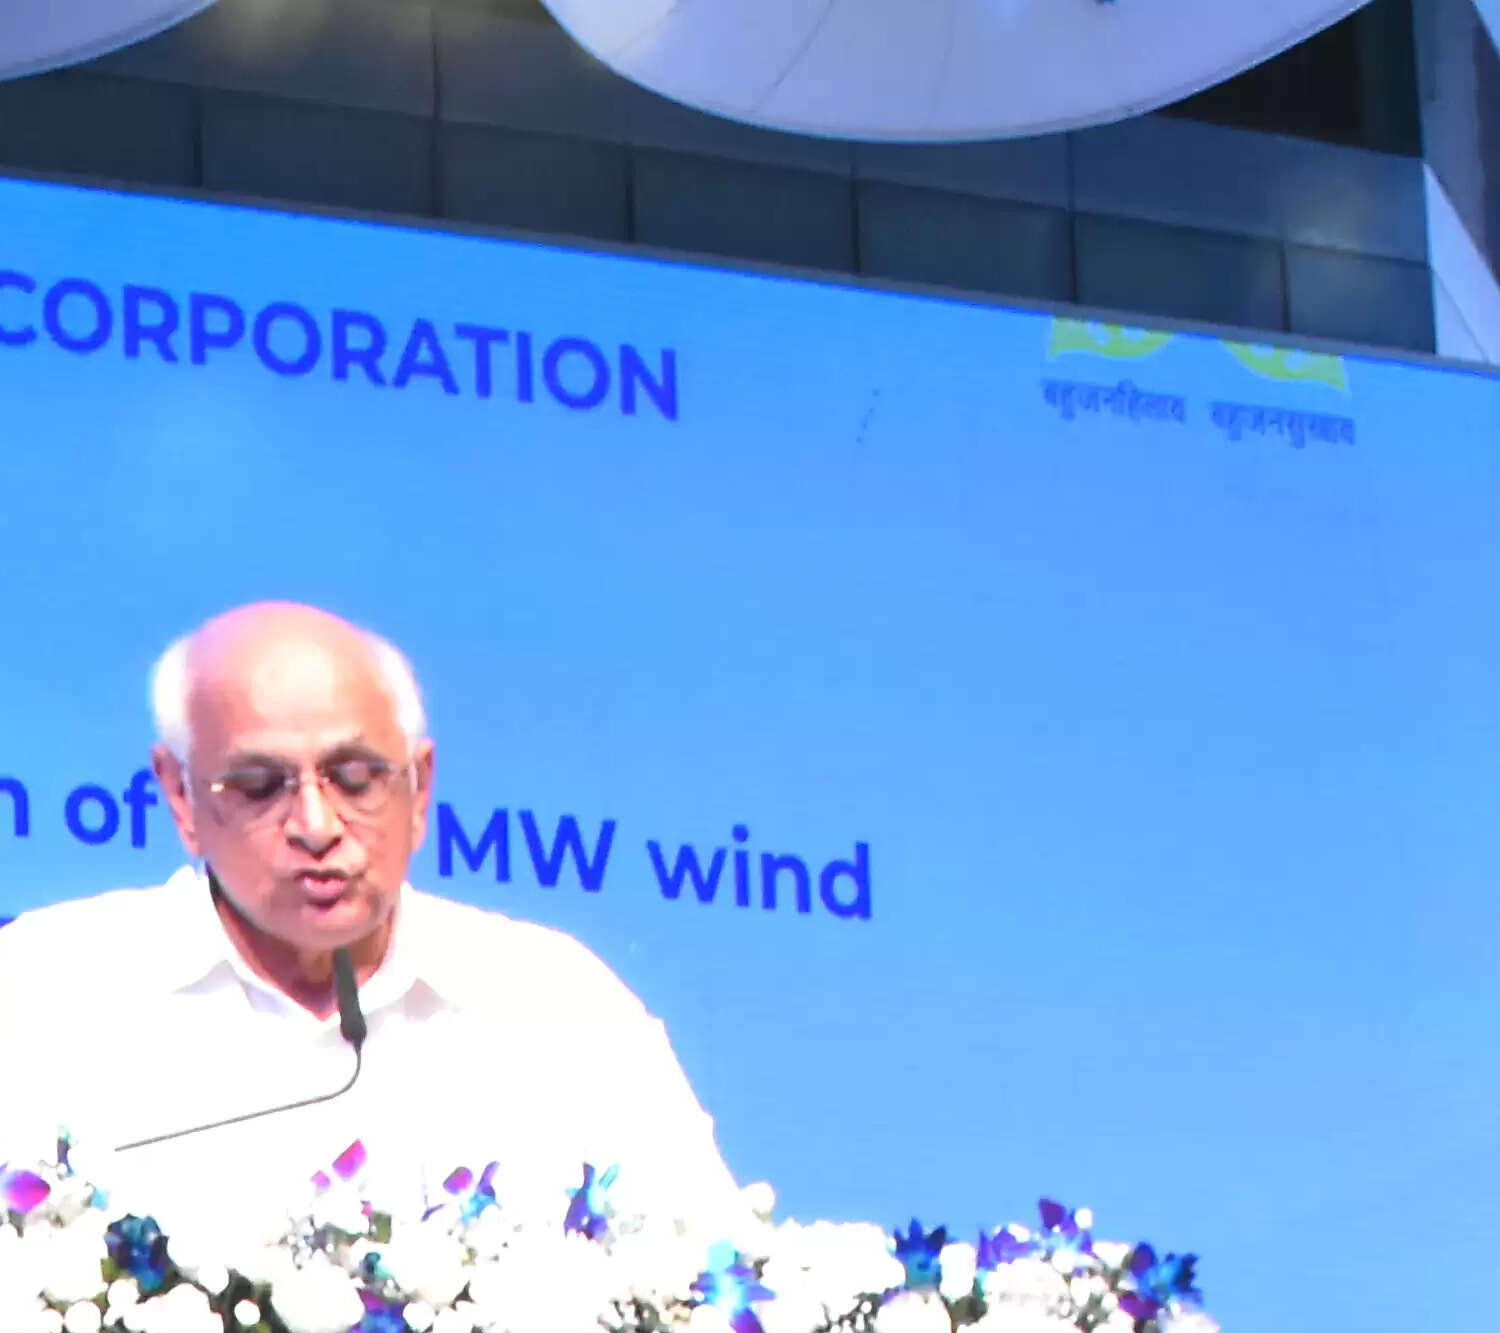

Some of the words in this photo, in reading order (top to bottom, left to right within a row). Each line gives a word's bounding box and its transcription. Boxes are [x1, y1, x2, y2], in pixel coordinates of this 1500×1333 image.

[64, 766, 158, 850] of
[437, 802, 617, 893] MW
[646, 824, 873, 921] wind
